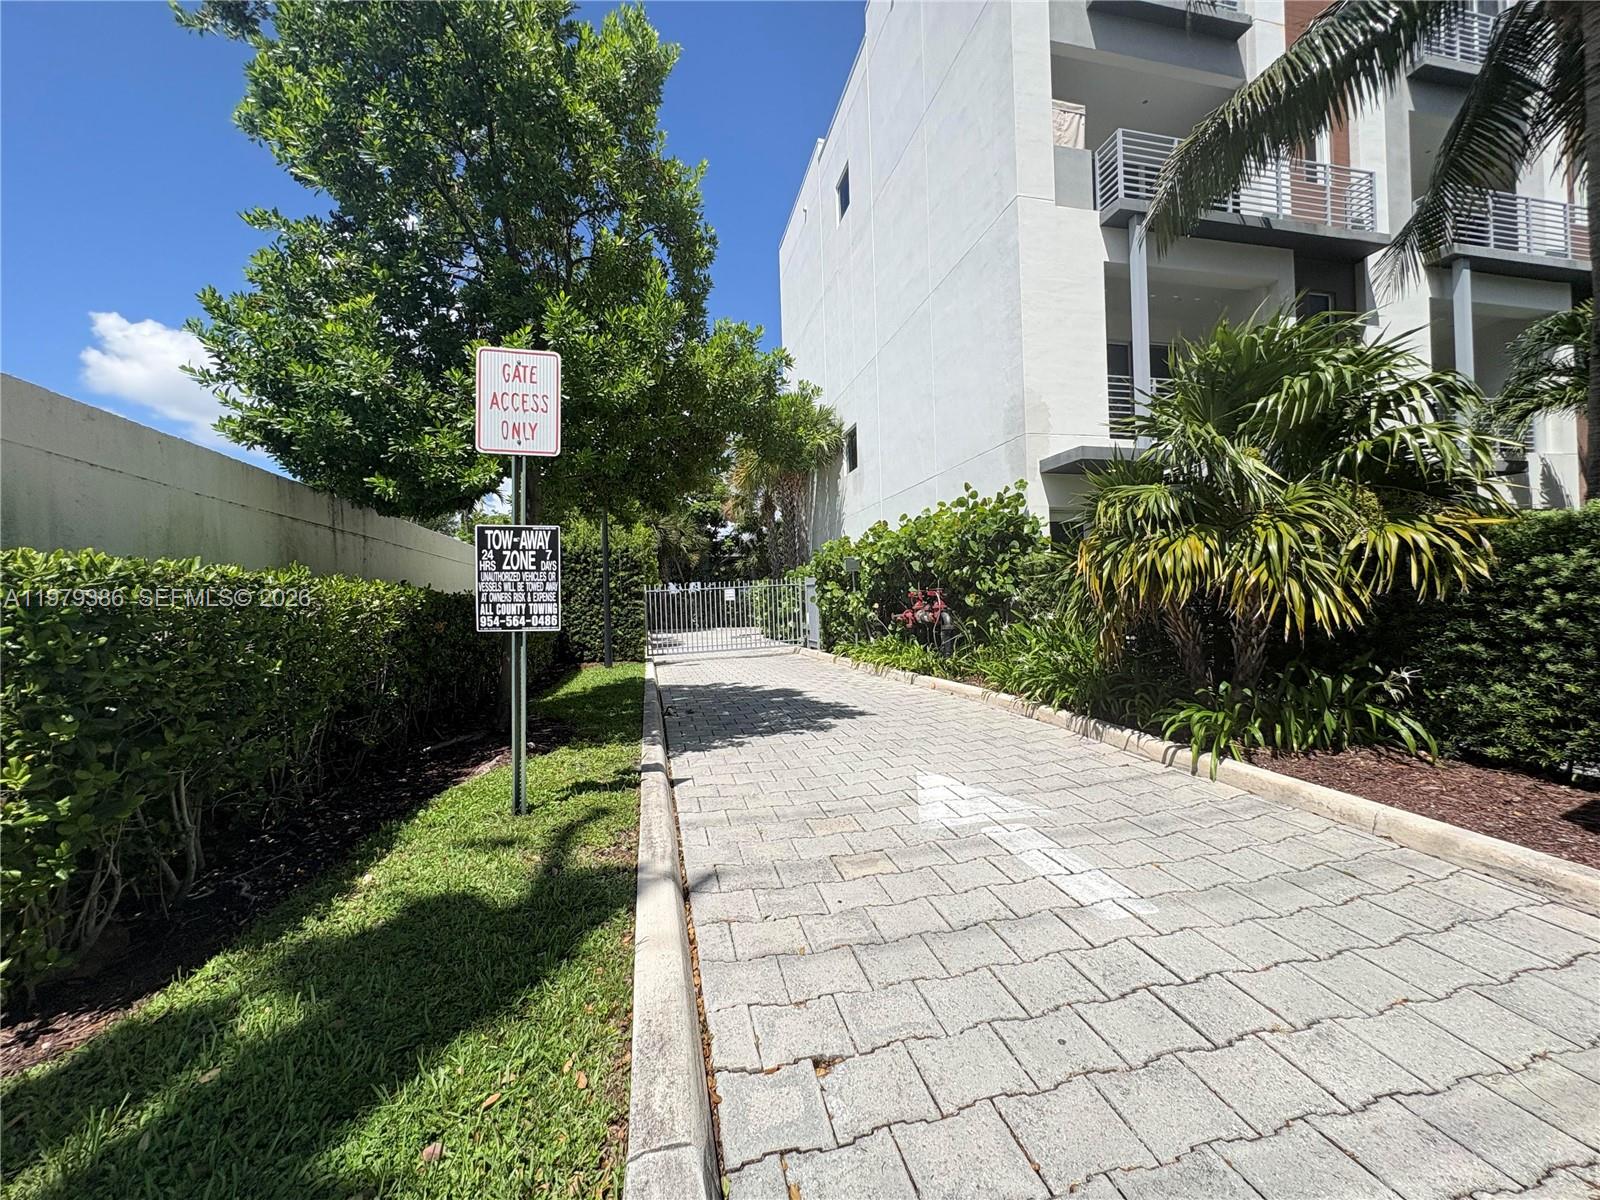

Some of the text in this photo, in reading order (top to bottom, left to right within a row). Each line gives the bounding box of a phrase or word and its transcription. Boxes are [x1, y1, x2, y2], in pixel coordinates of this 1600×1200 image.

[502, 363, 537, 384] GATE
[489, 391, 549, 414] ACCESS
[501, 420, 538, 441] ONLY
[484, 529, 551, 550] TOW-AWAY
[481, 549, 494, 560] 24
[502, 550, 536, 570] ZONE
[545, 549, 552, 560] 7
[479, 560, 496, 571] HRS
[541, 560, 557, 571] DAYS
[480, 571, 556, 581] UNAUTHORIZED VEHICLES OR
[479, 582, 558, 592] VESSELS WILL BE TOWED AWAY
[481, 592, 487, 602] AT
[513, 592, 526, 602] RISK
[533, 592, 557, 602] EXPENSE
[480, 603, 557, 615] ALL COUNTY TOWING
[480, 615, 557, 627] 954-564-0486
